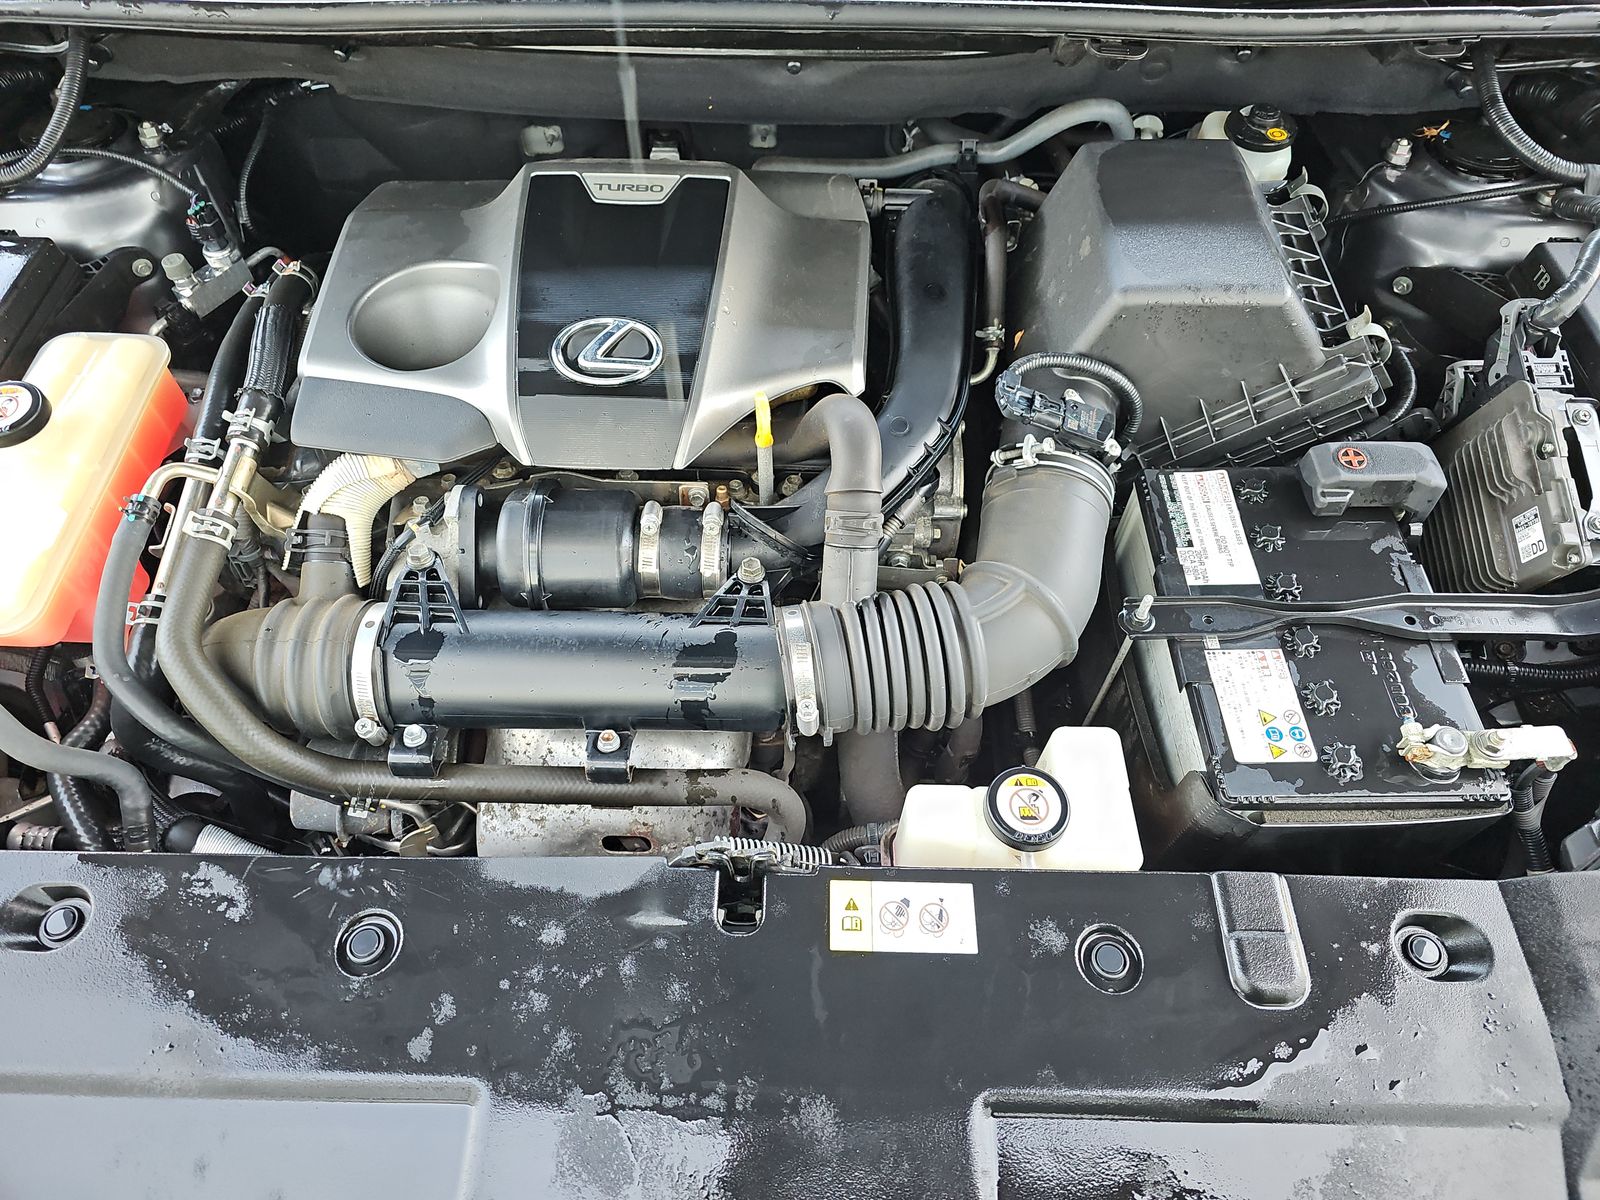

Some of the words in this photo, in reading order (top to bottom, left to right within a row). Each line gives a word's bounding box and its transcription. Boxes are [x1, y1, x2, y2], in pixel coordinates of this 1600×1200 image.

[593, 183, 664, 193] TURBO
[1533, 264, 1551, 291] TB
[1531, 540, 1545, 555] DD
[1187, 550, 1196, 564] CCA
[1195, 550, 1205, 566] 20HR
